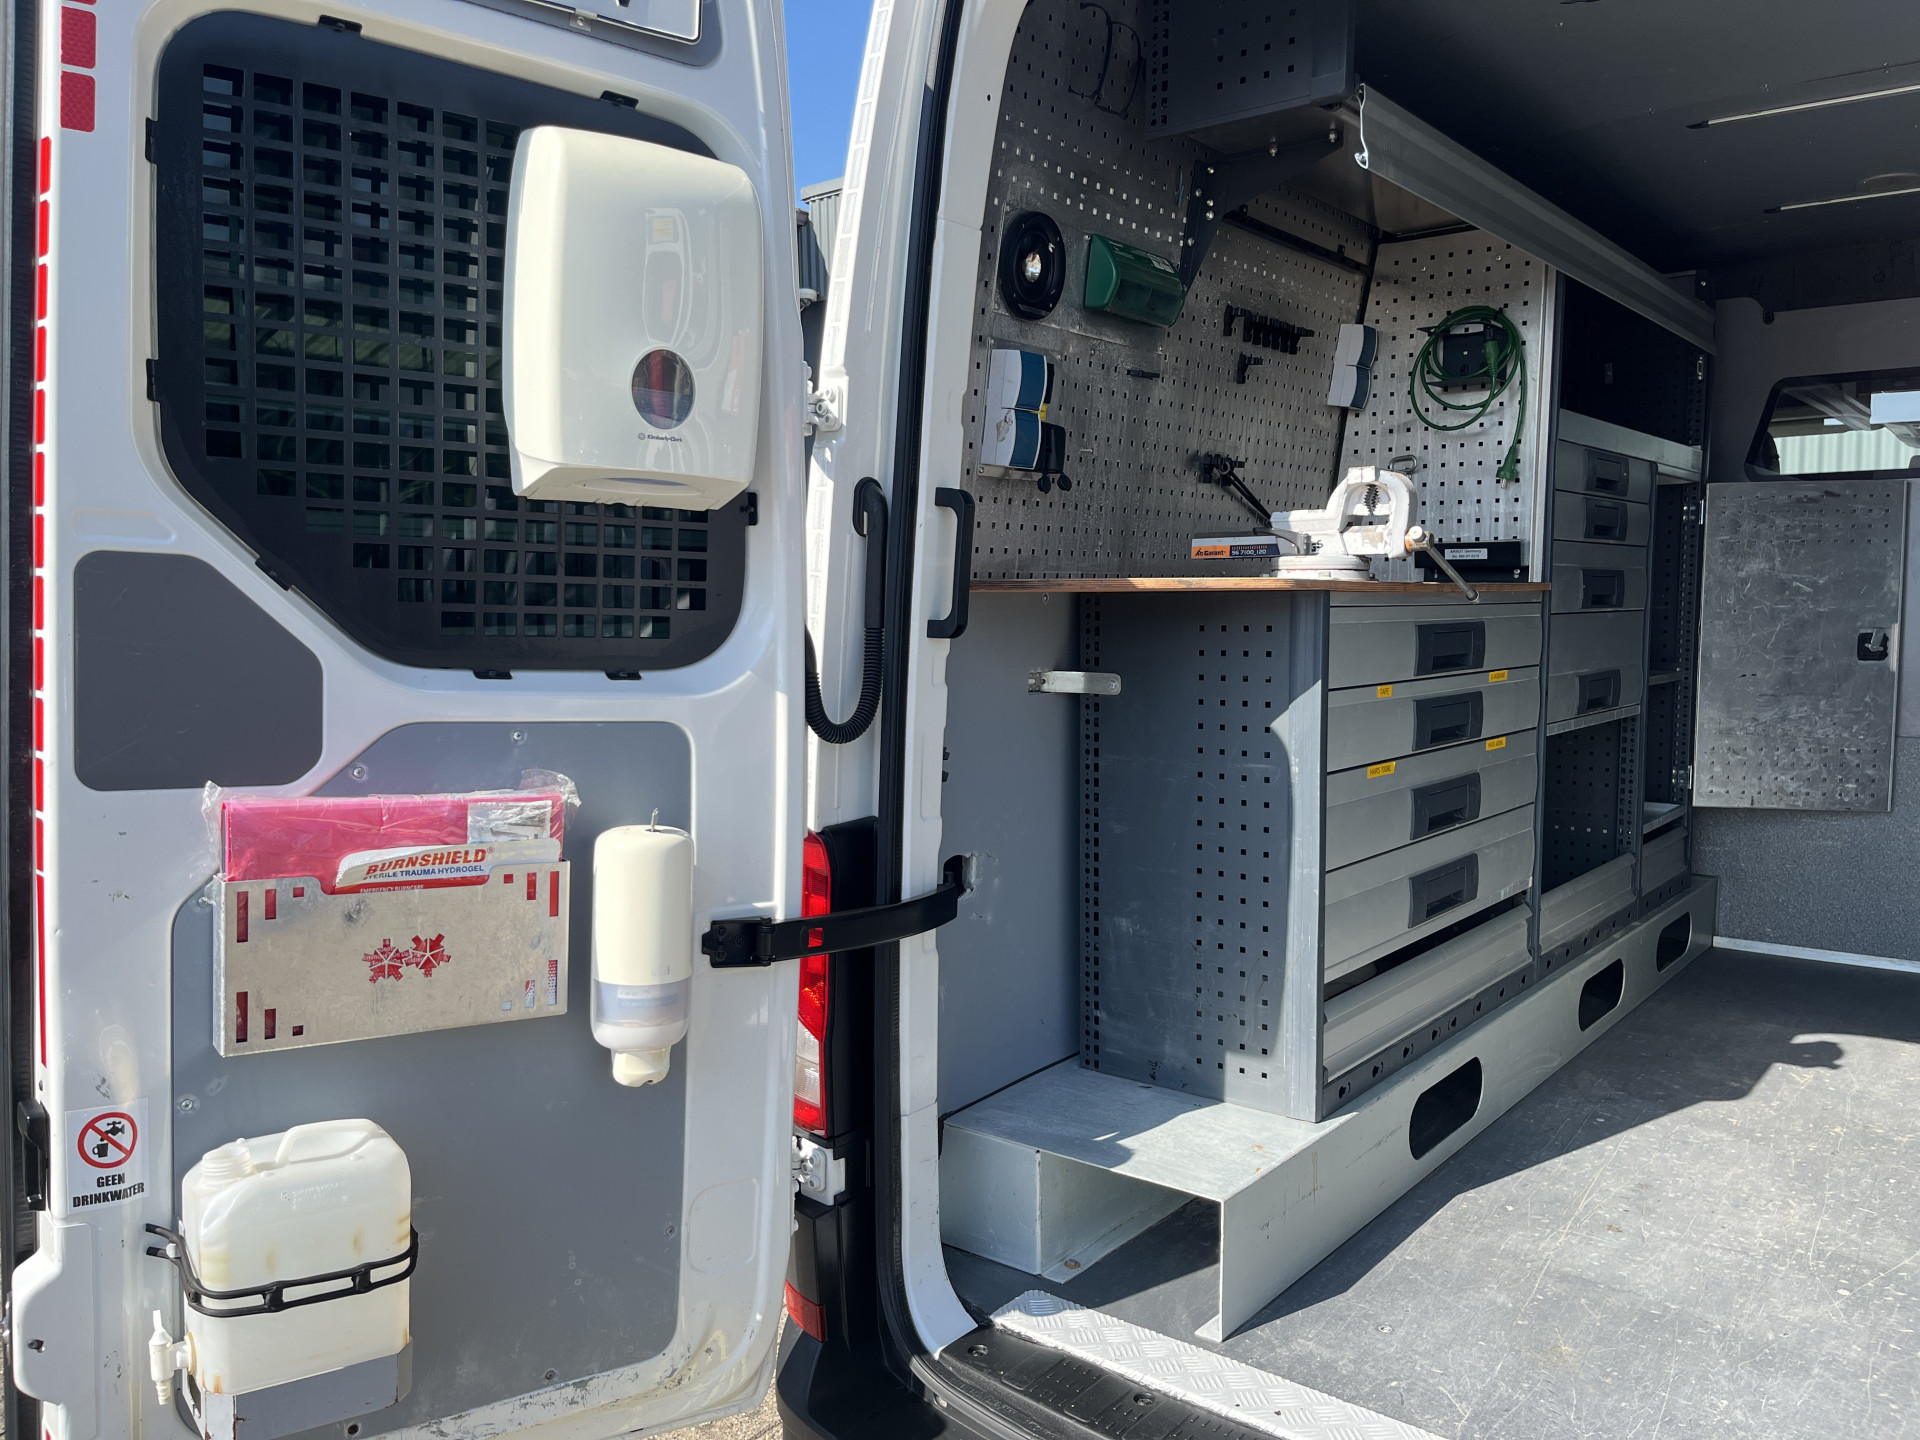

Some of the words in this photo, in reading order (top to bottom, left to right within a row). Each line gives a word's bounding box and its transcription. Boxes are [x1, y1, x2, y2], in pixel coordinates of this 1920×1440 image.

[363, 871, 398, 880] STERILE
[400, 868, 436, 877] TRAUMA
[437, 865, 484, 875] HYDROGEL
[96, 1172, 126, 1188] GEEN
[72, 1182, 145, 1208] DRINKWATER
